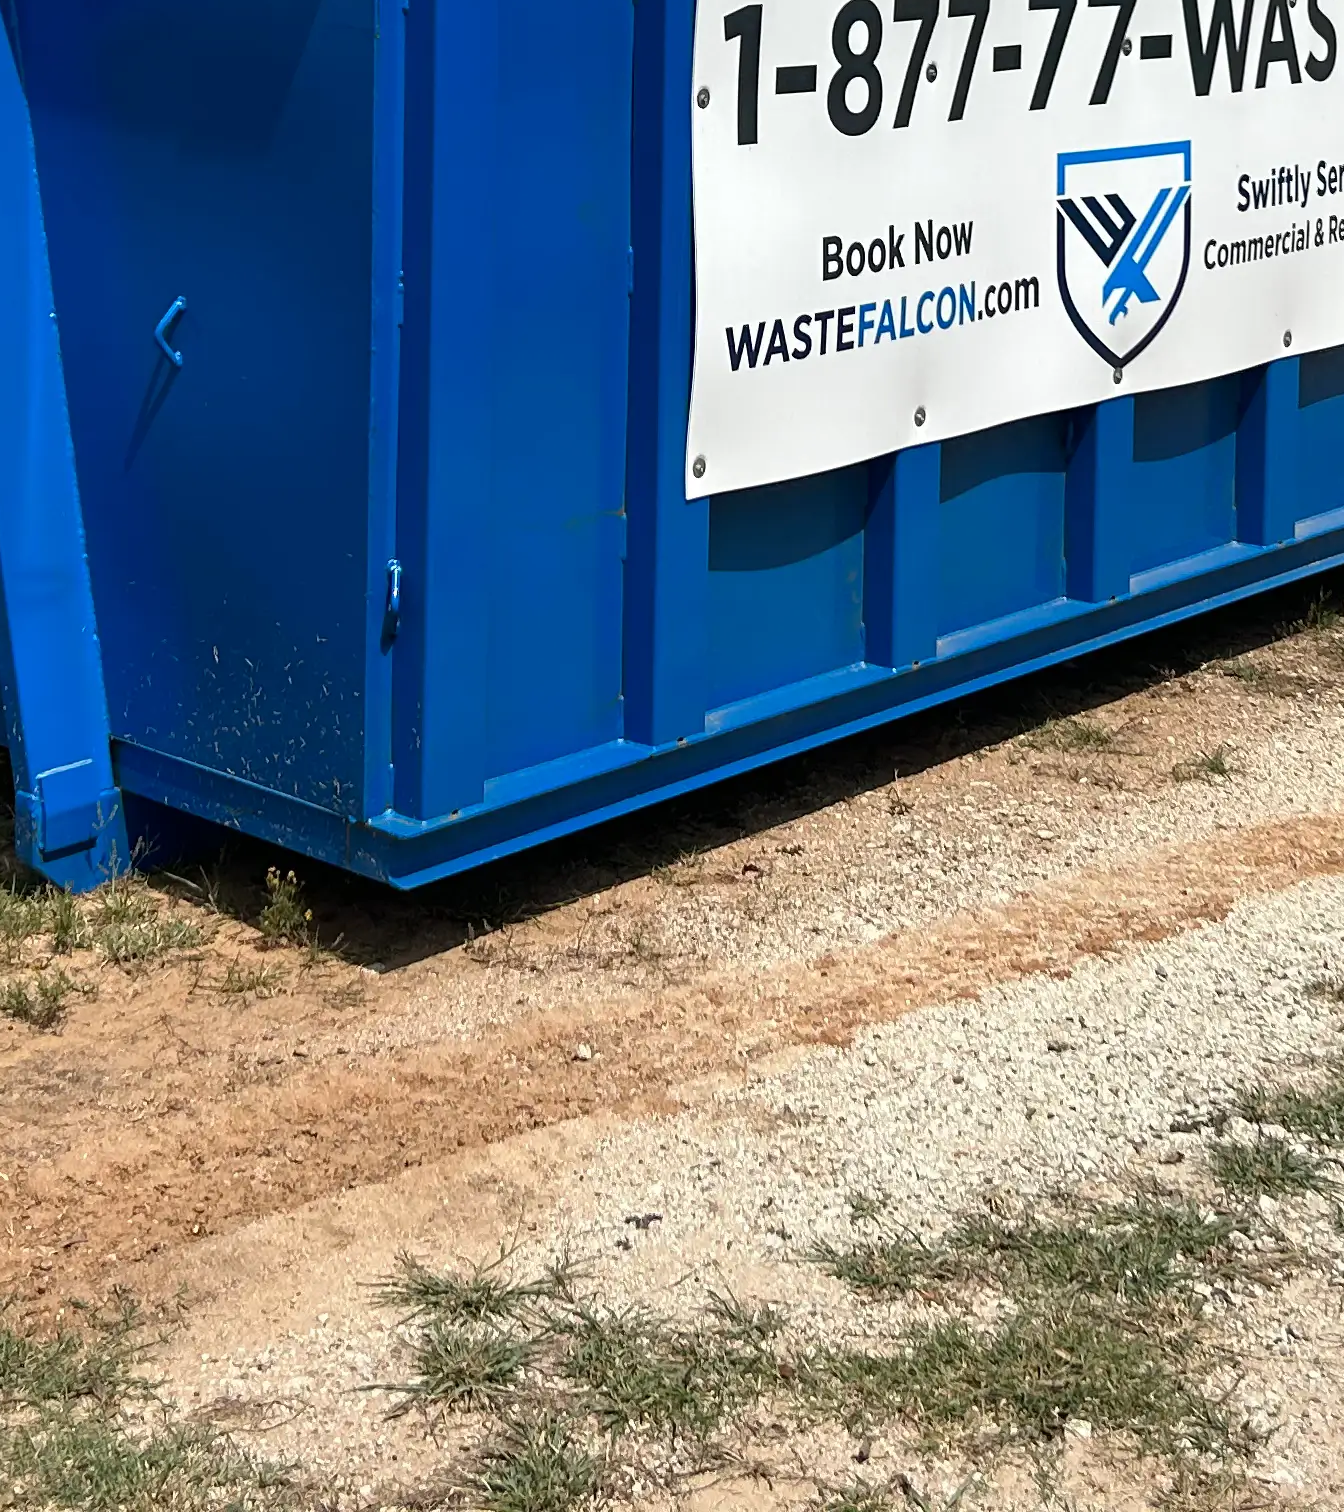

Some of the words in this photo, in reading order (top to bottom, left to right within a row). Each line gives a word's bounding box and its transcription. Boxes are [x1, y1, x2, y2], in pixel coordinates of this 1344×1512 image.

[1237, 164, 1311, 212] Swiftly
[822, 225, 905, 281] Book
[915, 219, 973, 265] Now
[1204, 220, 1310, 270] Commercial
[1314, 218, 1324, 247] &
[725, 276, 1039, 371] WASTEFALCON.com
